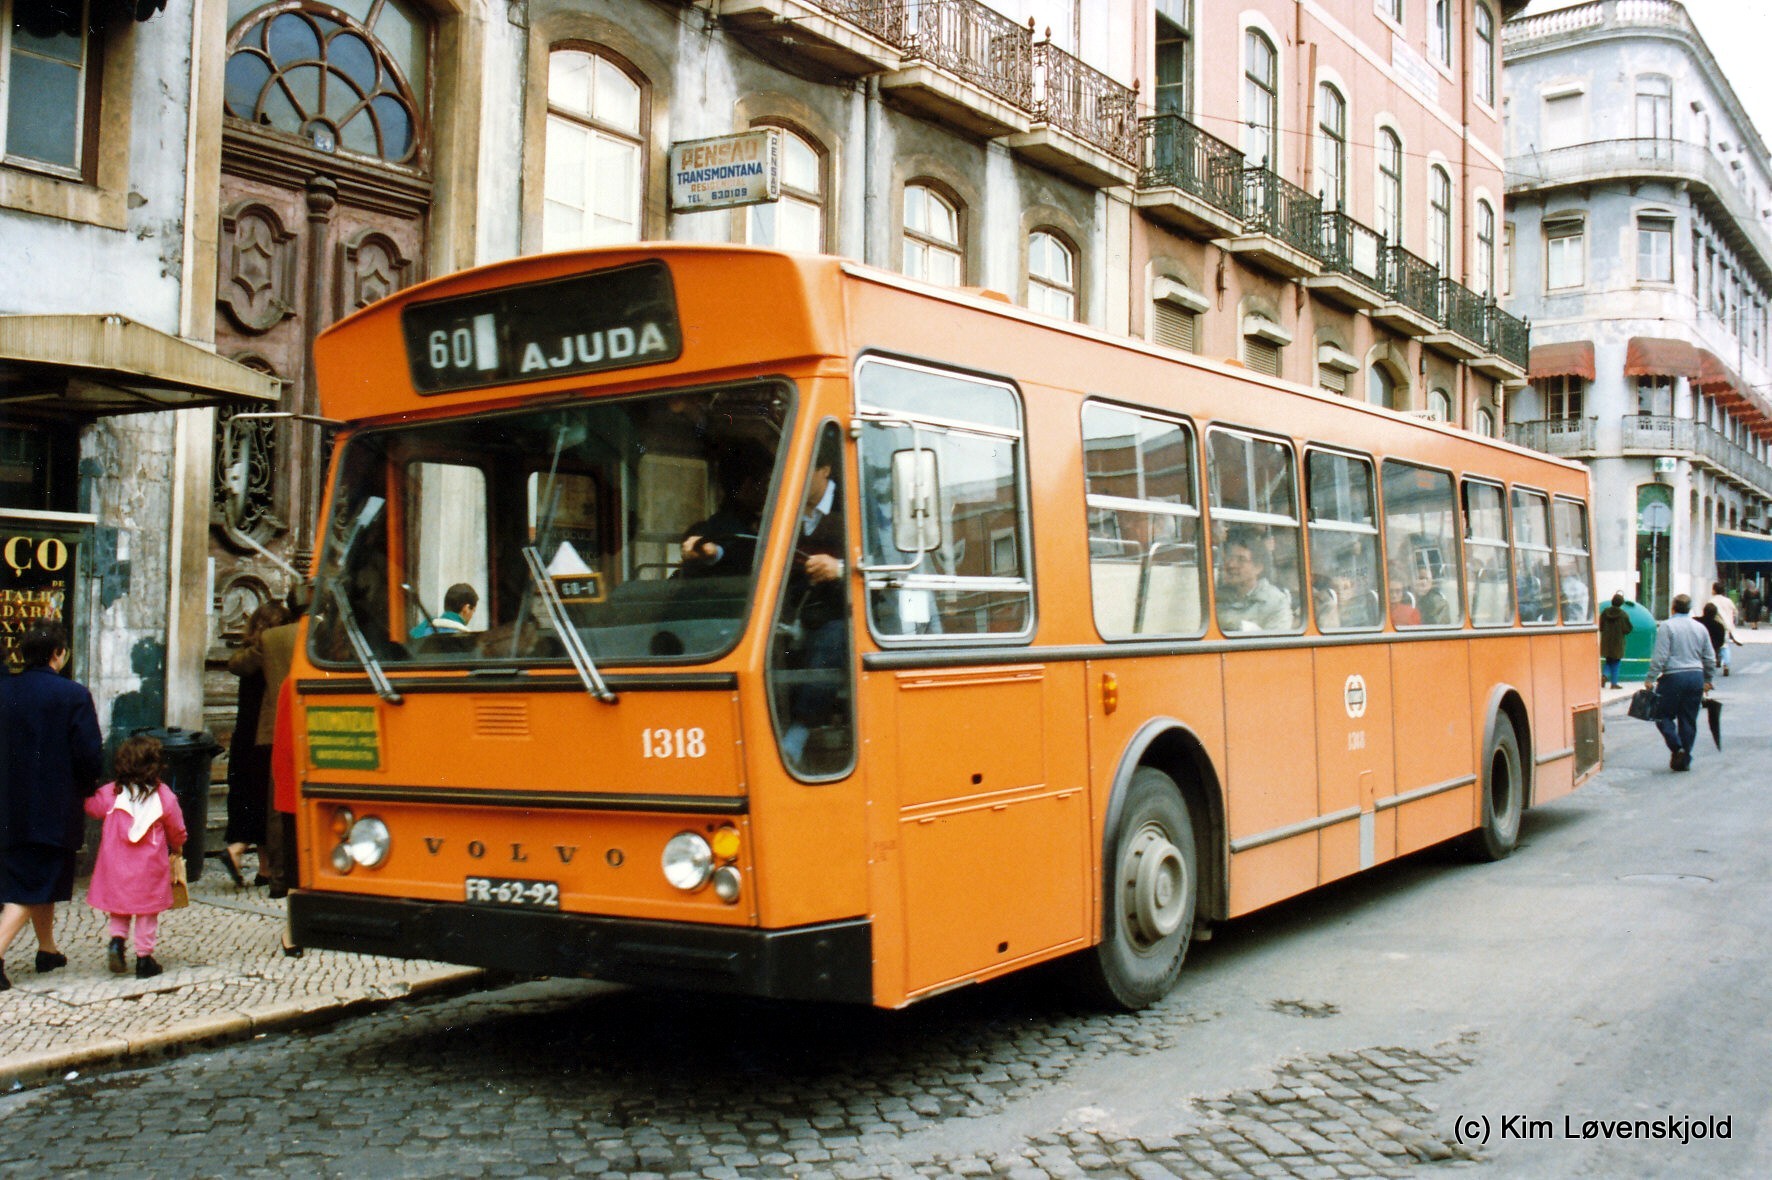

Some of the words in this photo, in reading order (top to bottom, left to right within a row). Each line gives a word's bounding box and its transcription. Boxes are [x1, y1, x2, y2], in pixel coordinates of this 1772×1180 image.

[677, 162, 763, 185] TRANSMONTANA
[687, 194, 703, 203] TEL.
[711, 188, 748, 200] 630109
[428, 327, 473, 369] 60
[520, 322, 668, 373] AJUDA
[0, 589, 65, 603] TALHO
[642, 727, 707, 758] 1318
[424, 837, 625, 867] VOLVO
[465, 877, 559, 907] FR-62-92
